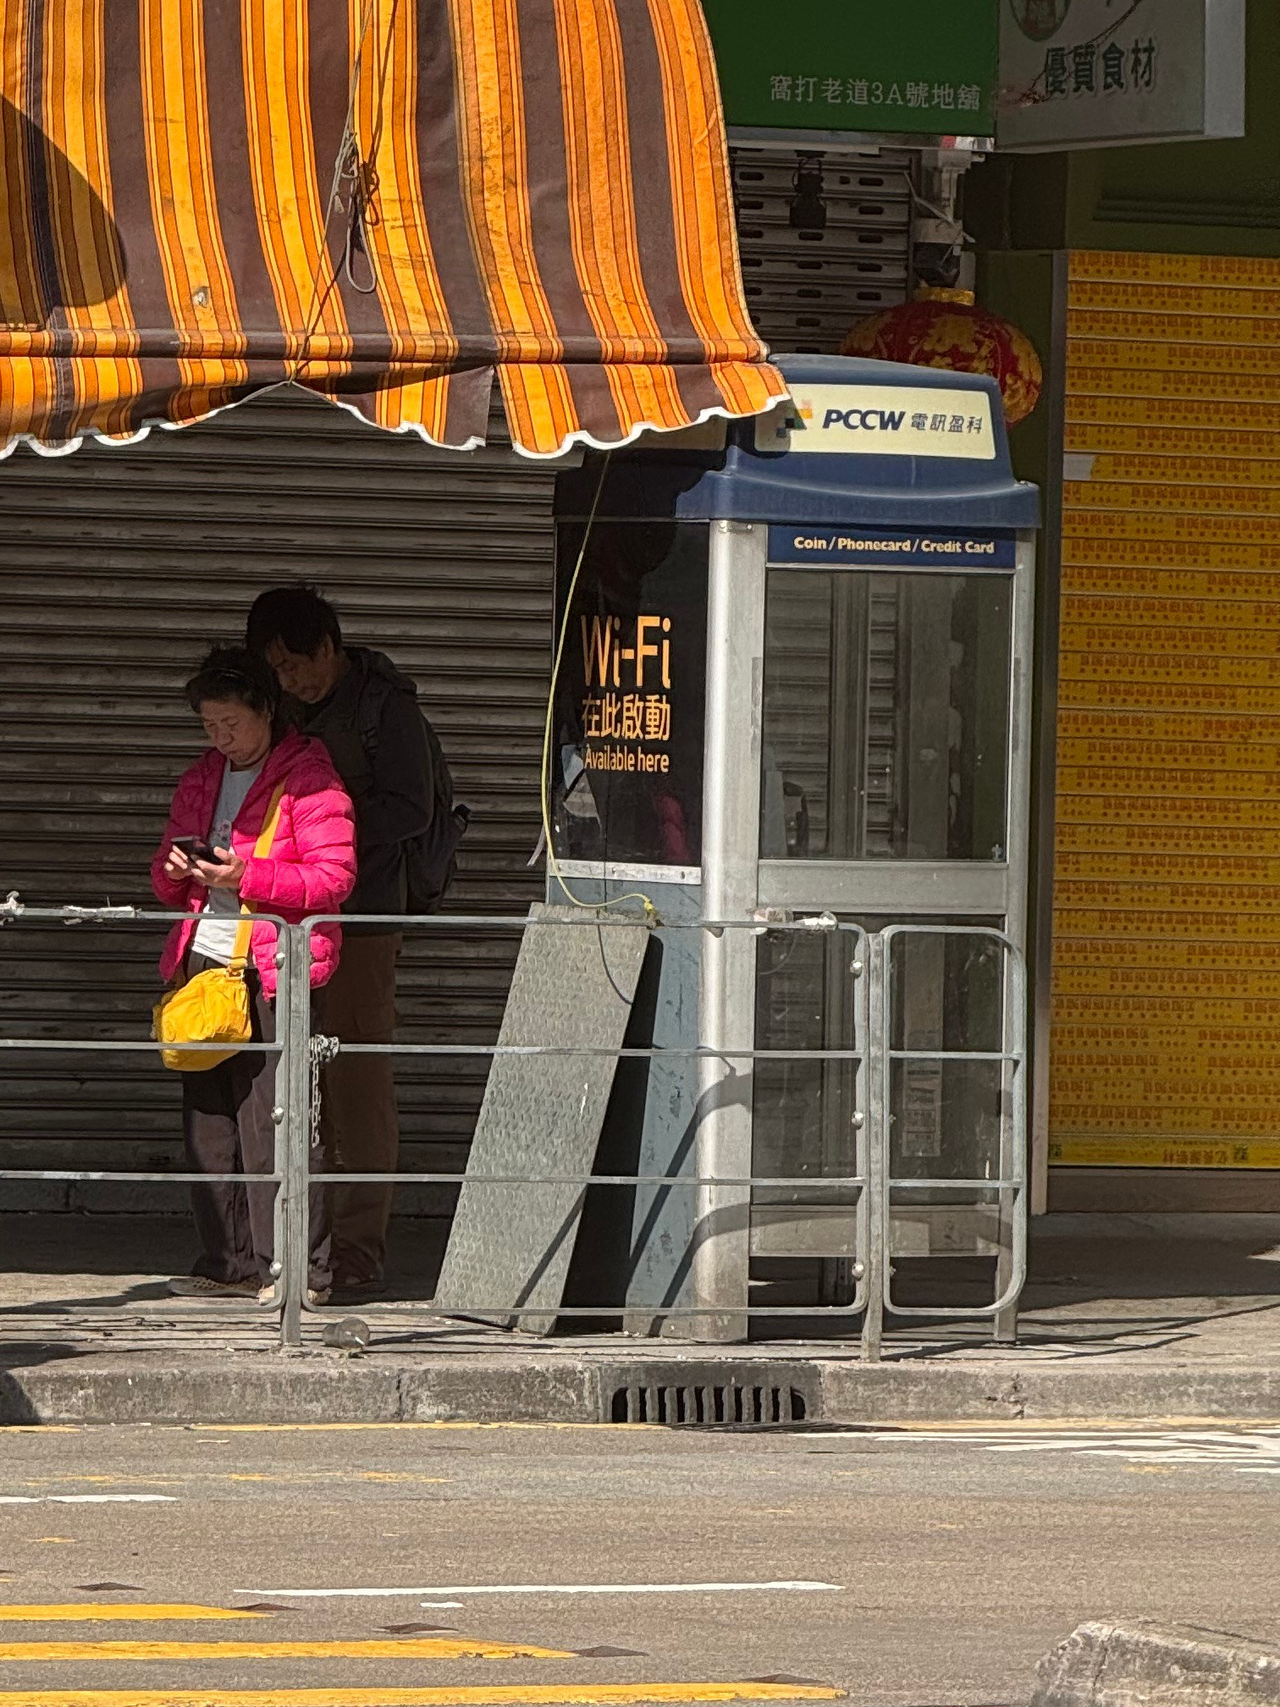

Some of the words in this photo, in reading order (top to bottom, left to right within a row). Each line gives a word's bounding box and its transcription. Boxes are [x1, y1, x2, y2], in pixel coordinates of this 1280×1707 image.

[1045, 37, 1156, 94] 優質食材
[822, 408, 906, 431] PCCW
[910, 412, 983, 434] 電訊盈科
[793, 537, 827, 549] Coin
[837, 538, 911, 552] Phonecard
[921, 540, 961, 553] Credit
[965, 541, 995, 554] Card
[581, 614, 671, 690] Wi-Fi
[584, 743, 635, 772] Available
[637, 745, 670, 773] here
